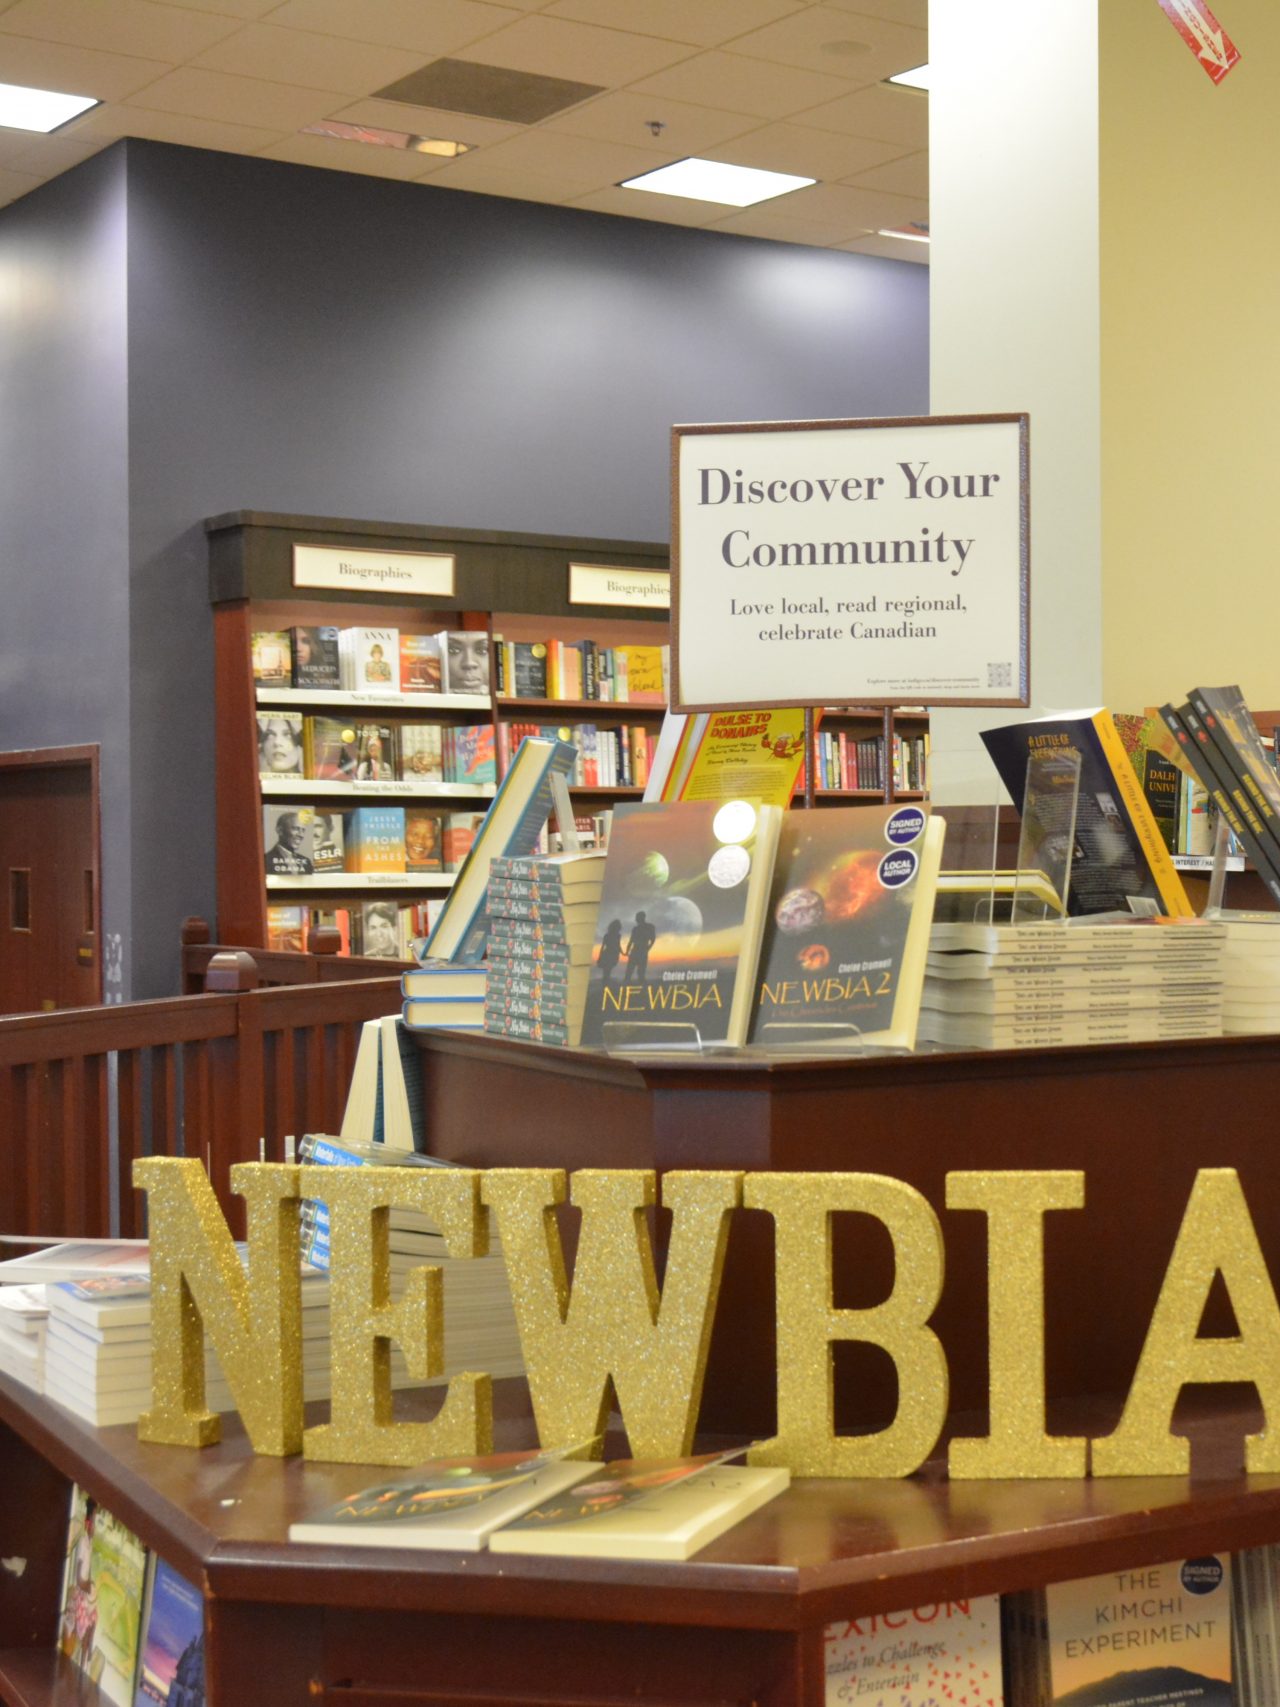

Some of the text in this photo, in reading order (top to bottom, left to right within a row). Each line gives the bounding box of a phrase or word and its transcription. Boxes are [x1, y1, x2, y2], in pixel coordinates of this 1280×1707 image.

[698, 461, 1000, 505] Discover Your
[721, 527, 975, 576] Community
[338, 561, 413, 583] Biographies
[730, 594, 967, 617] Love local, read regional,
[758, 621, 937, 641] celebrate Canadian
[715, 713, 771, 726] DULSE TO
[710, 724, 768, 739] DONAIRS
[890, 818, 922, 828] SIGNED
[897, 826, 920, 834] AUTHOR
[883, 869, 910, 877] AUTHOR
[884, 860, 912, 870] LOCAL
[602, 984, 722, 1011] NEWBIA
[760, 972, 891, 1005] NEWBIA 2
[1115, 1570, 1161, 1592] THE
[1183, 1566, 1220, 1575] SIGNED
[1096, 1597, 1182, 1625] KIMCHI
[1065, 1621, 1216, 1659] EXPERIMENT
[863, 1654, 875, 1666] to
[880, 1641, 945, 1665] Challenge
[856, 1672, 920, 1696] Entertain
